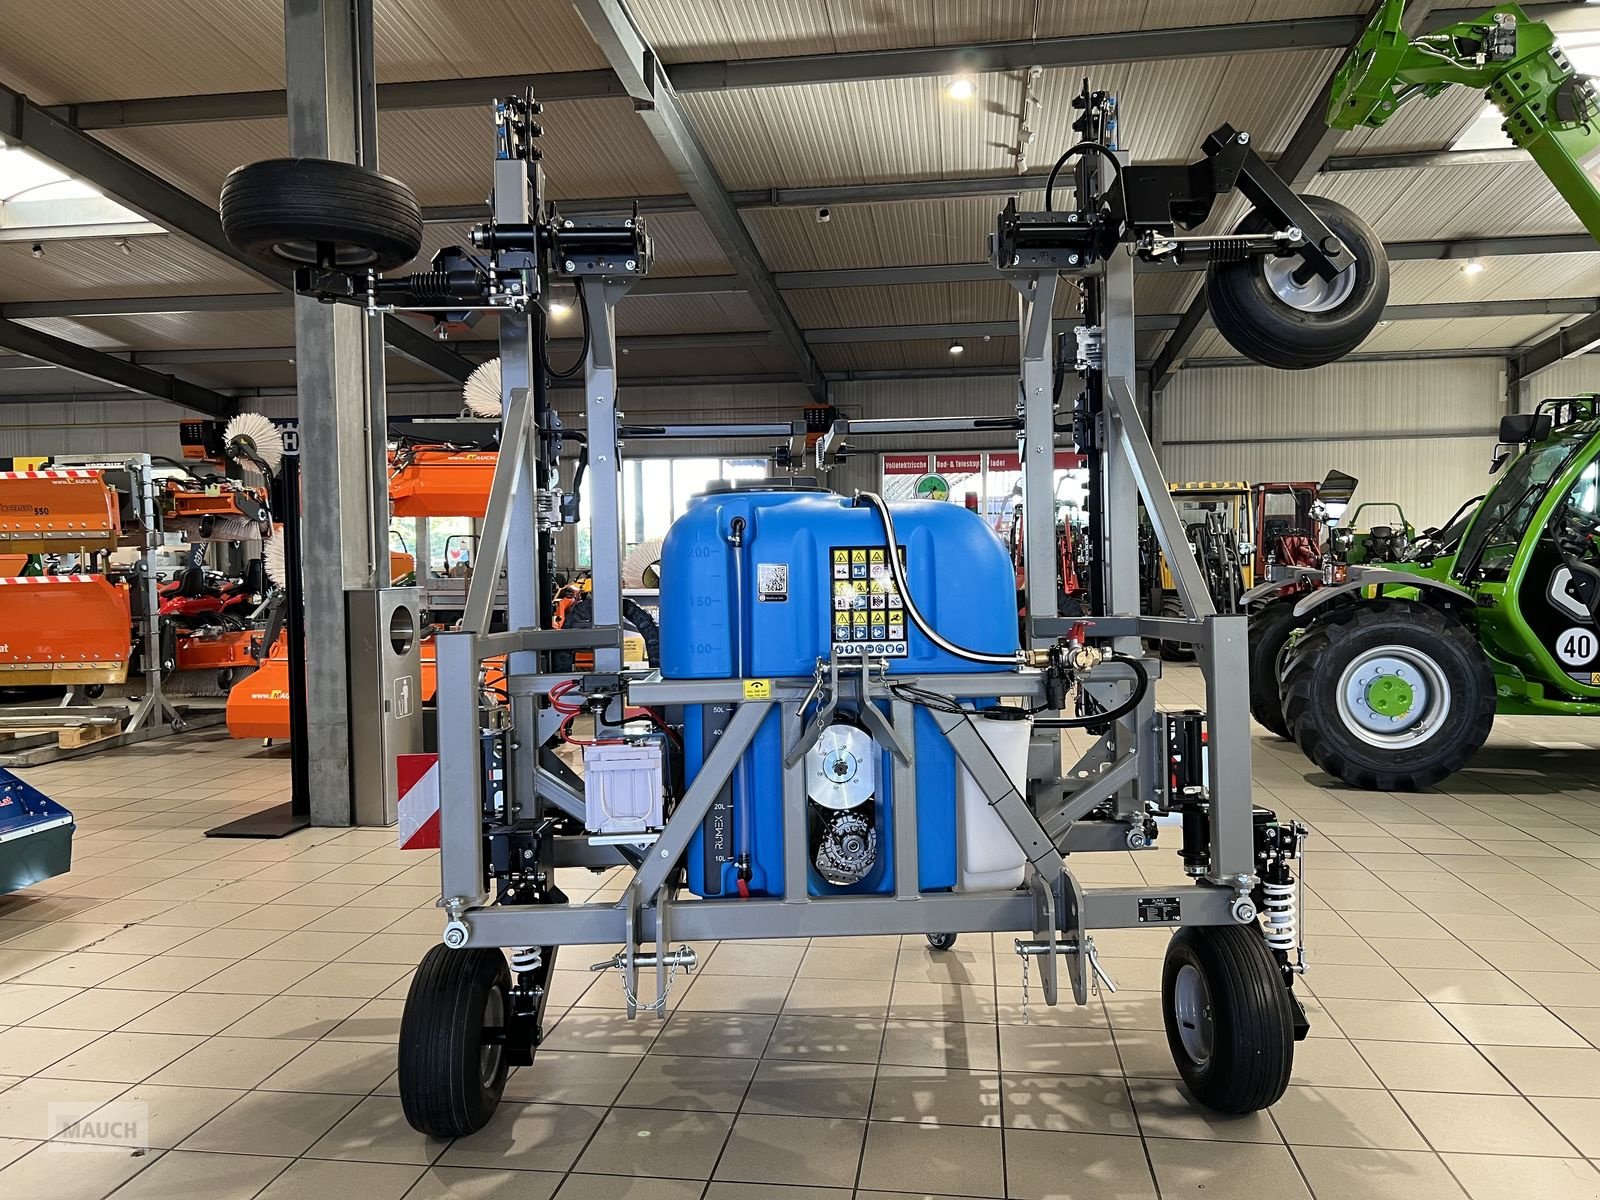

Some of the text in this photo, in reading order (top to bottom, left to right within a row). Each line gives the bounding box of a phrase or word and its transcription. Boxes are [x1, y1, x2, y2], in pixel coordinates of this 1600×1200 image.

[33, 507, 49, 516] 550
[687, 546, 710, 558] 200
[690, 596, 712, 608] 150
[690, 643, 712, 655] 100
[1563, 635, 1590, 659] 40
[714, 815, 724, 850] RUMEX
